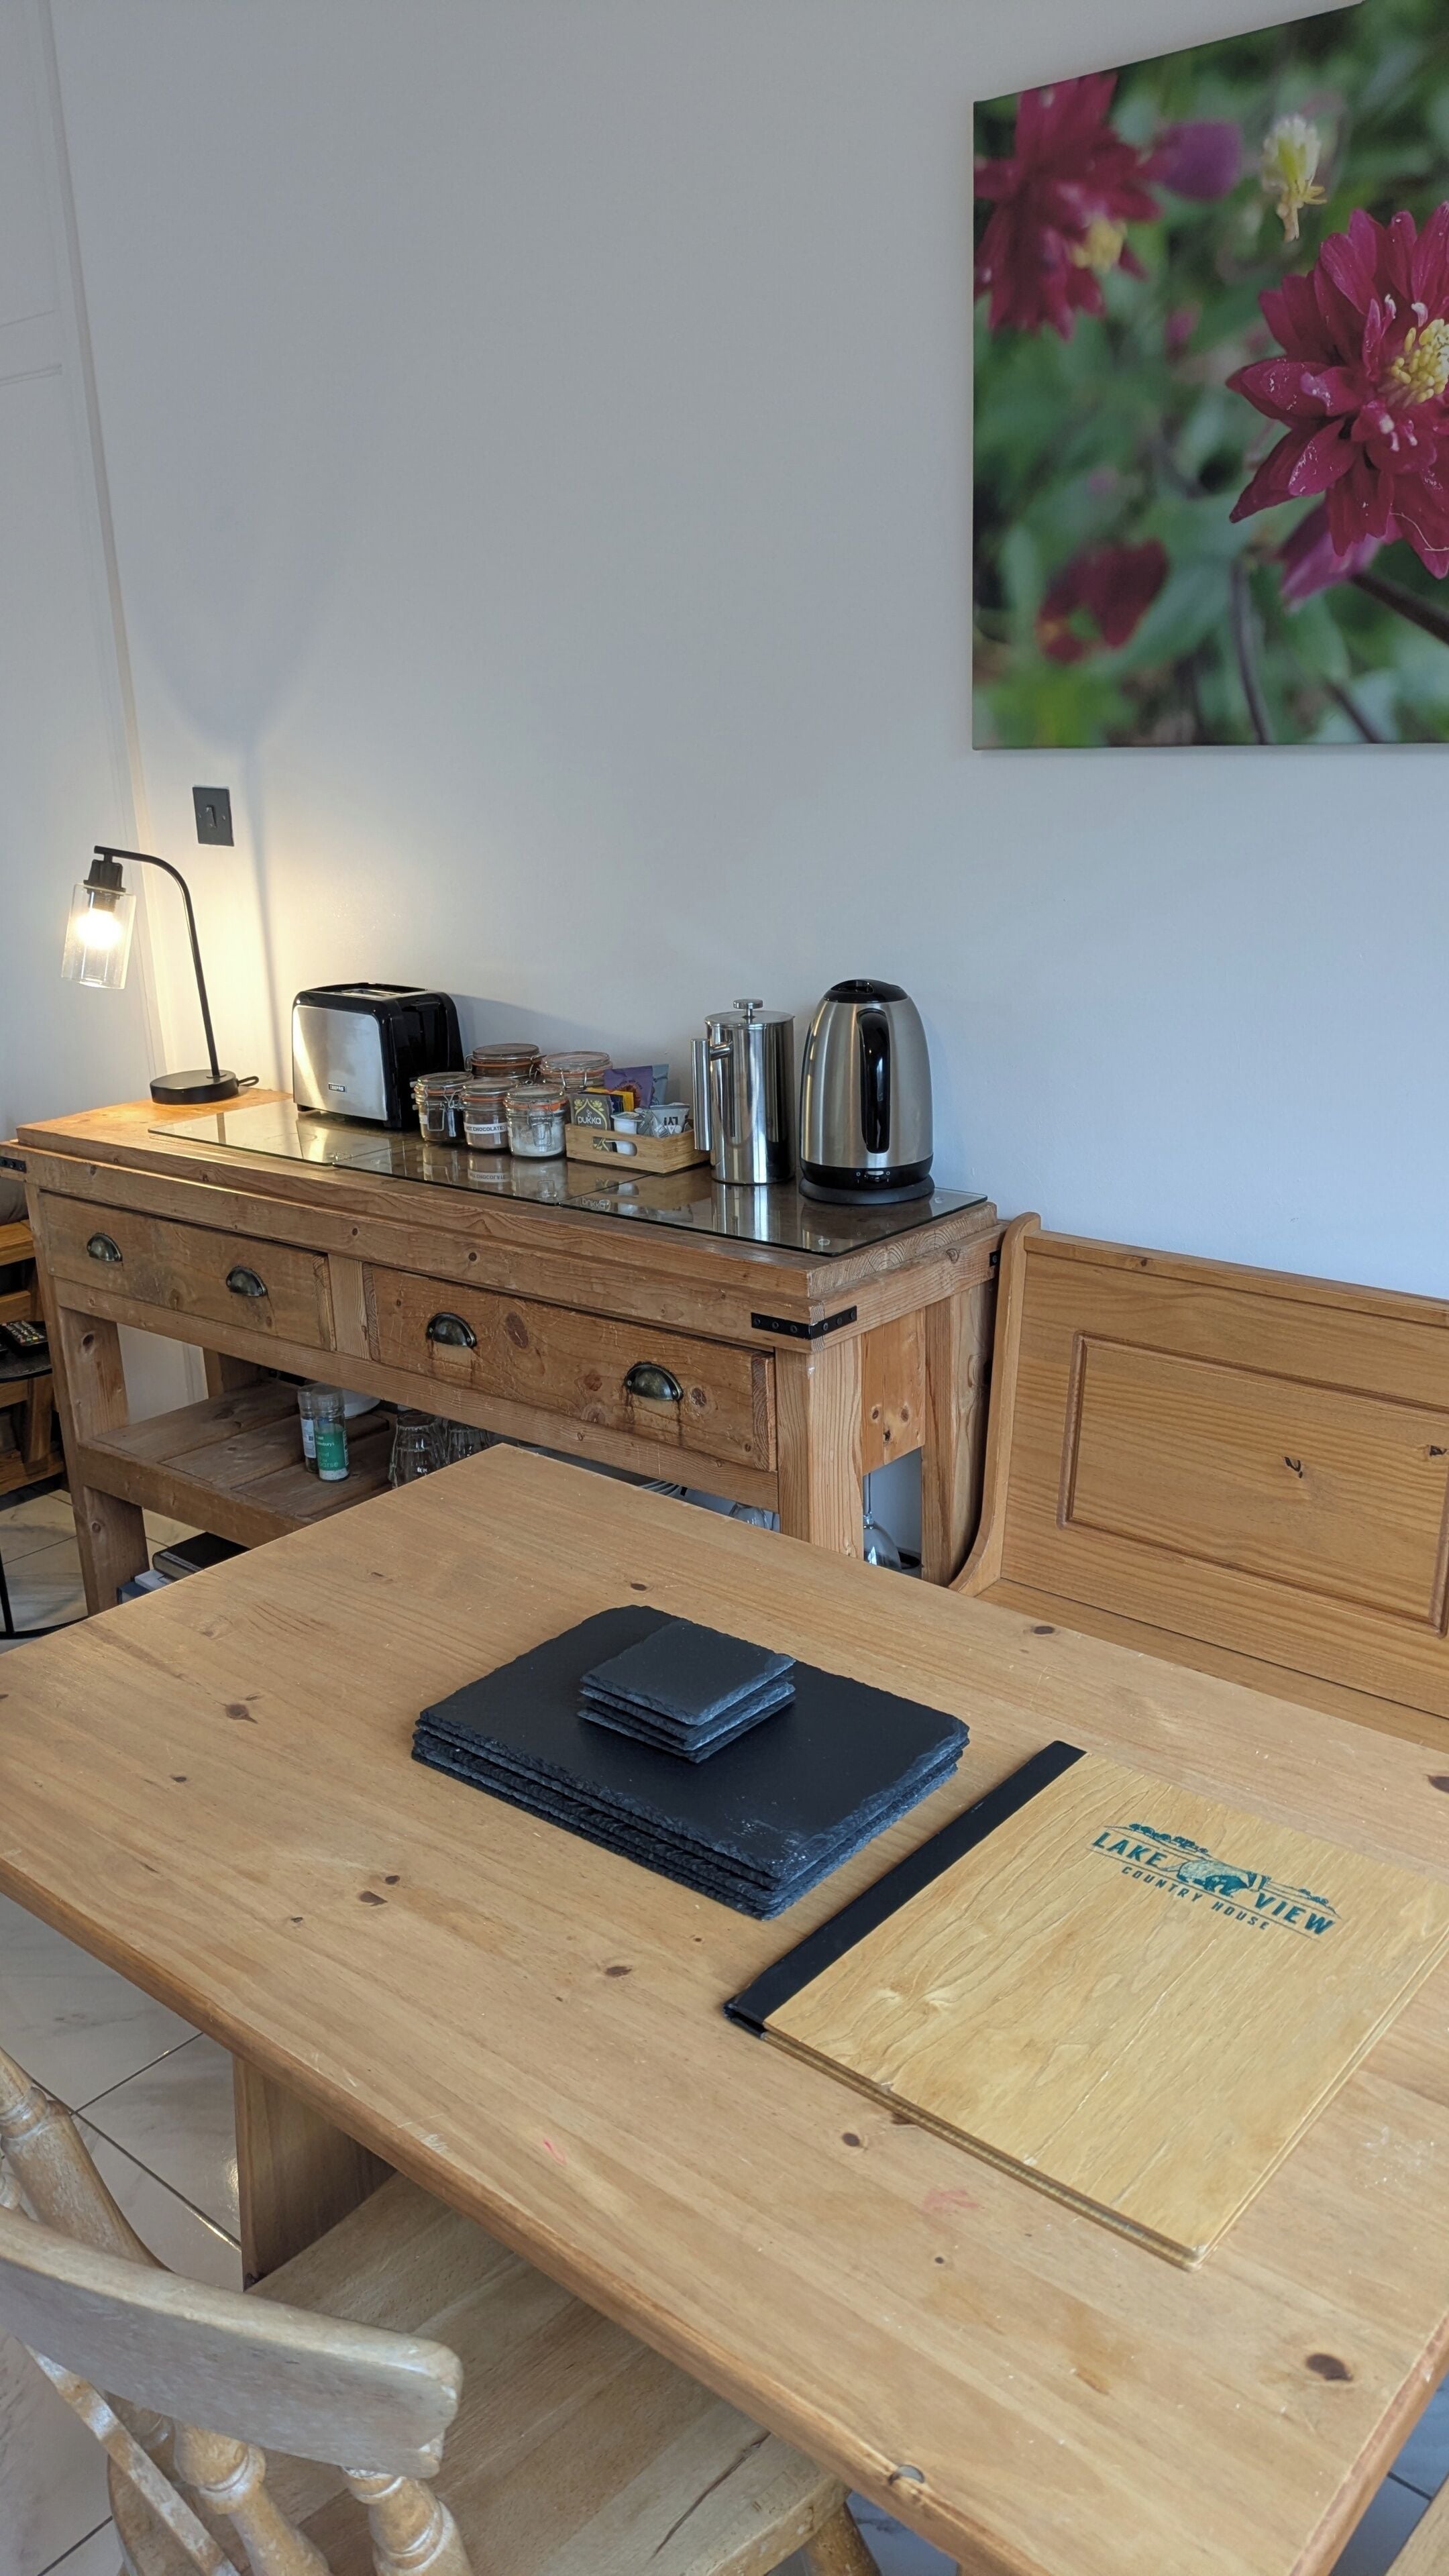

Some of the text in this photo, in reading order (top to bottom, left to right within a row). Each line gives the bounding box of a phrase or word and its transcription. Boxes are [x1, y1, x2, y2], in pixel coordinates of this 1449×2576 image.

[578, 1115, 602, 1125] pukka
[1092, 1832, 1336, 1935] LAKE VIEW
[1122, 1866, 1271, 1930] COUNTRY HOUSE
